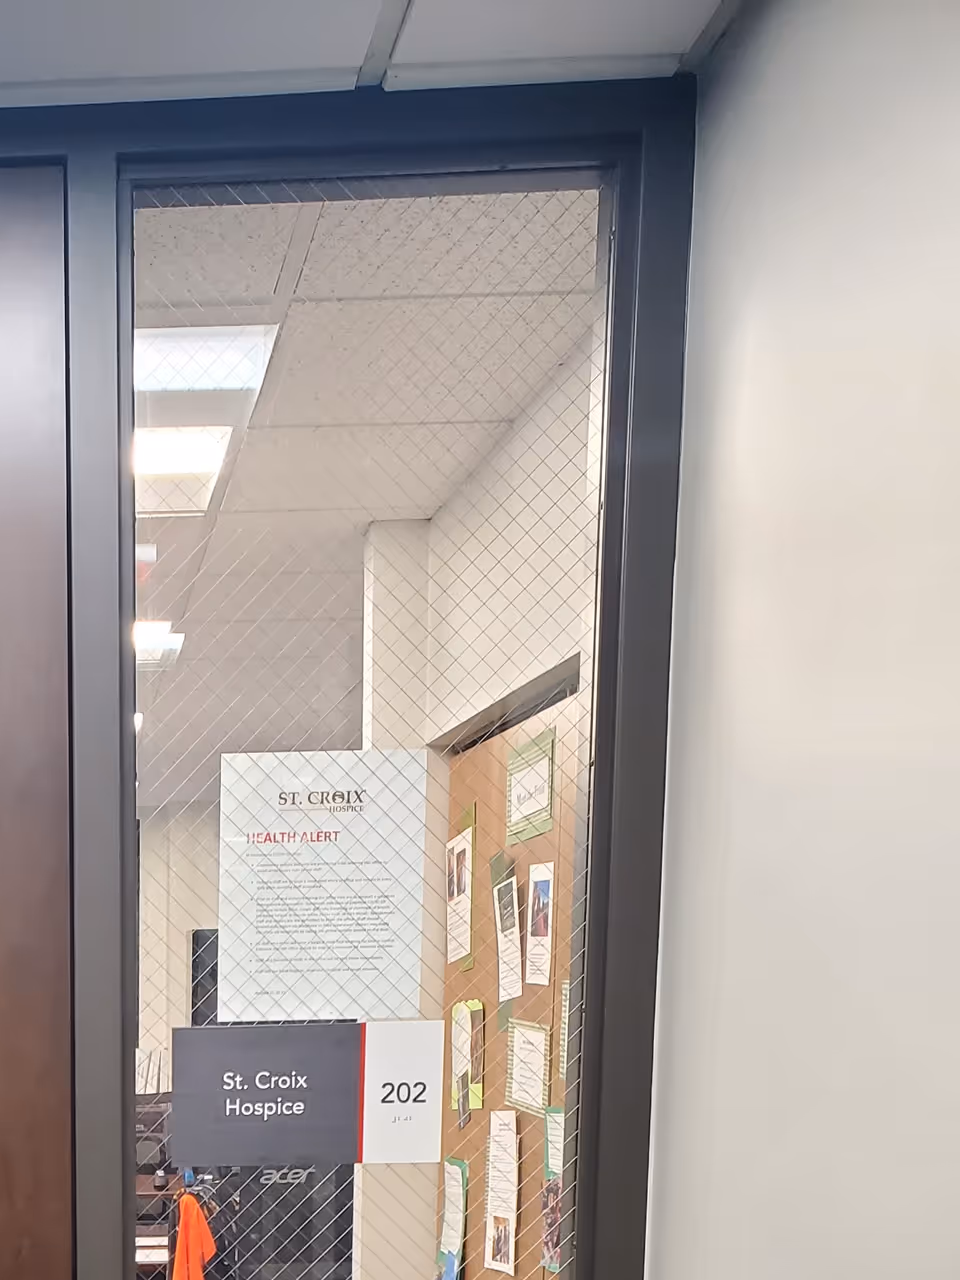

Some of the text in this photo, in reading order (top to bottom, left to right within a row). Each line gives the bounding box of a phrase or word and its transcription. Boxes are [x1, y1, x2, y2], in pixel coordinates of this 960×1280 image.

[278, 790, 366, 805] ST. CROIX
[329, 805, 364, 813] HOSPICE
[247, 831, 341, 844] HEALTH ALERT
[223, 1071, 308, 1090] St. Croix
[381, 1082, 427, 1103] 202
[225, 1098, 305, 1120] Hospice
[260, 1166, 315, 1184] acer
